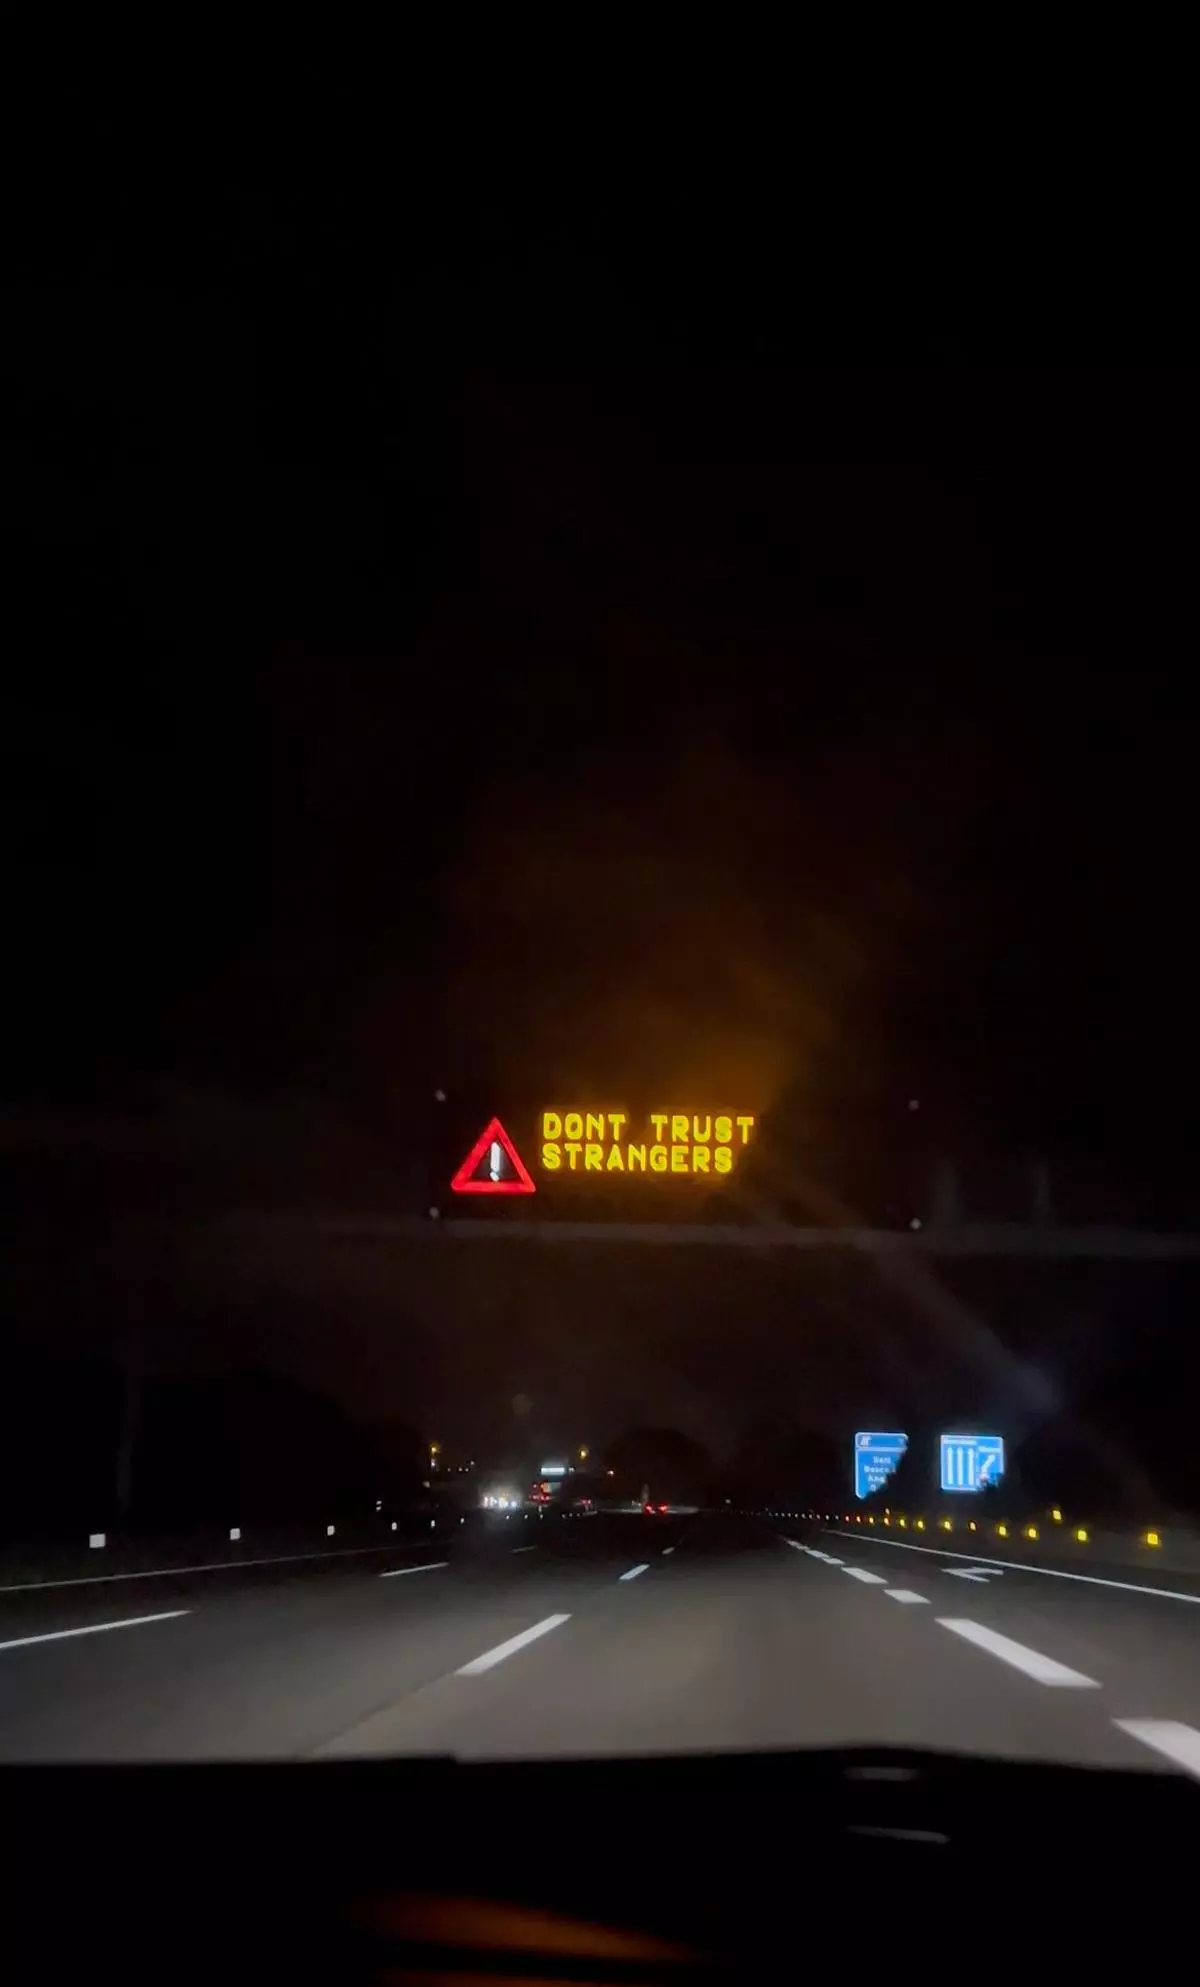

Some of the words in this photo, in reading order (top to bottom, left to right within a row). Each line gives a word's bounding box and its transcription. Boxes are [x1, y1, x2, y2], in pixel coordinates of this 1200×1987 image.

[542, 1113, 626, 1140] DONT
[650, 1115, 755, 1144] TRUST
[542, 1143, 733, 1173] STRANGERS
